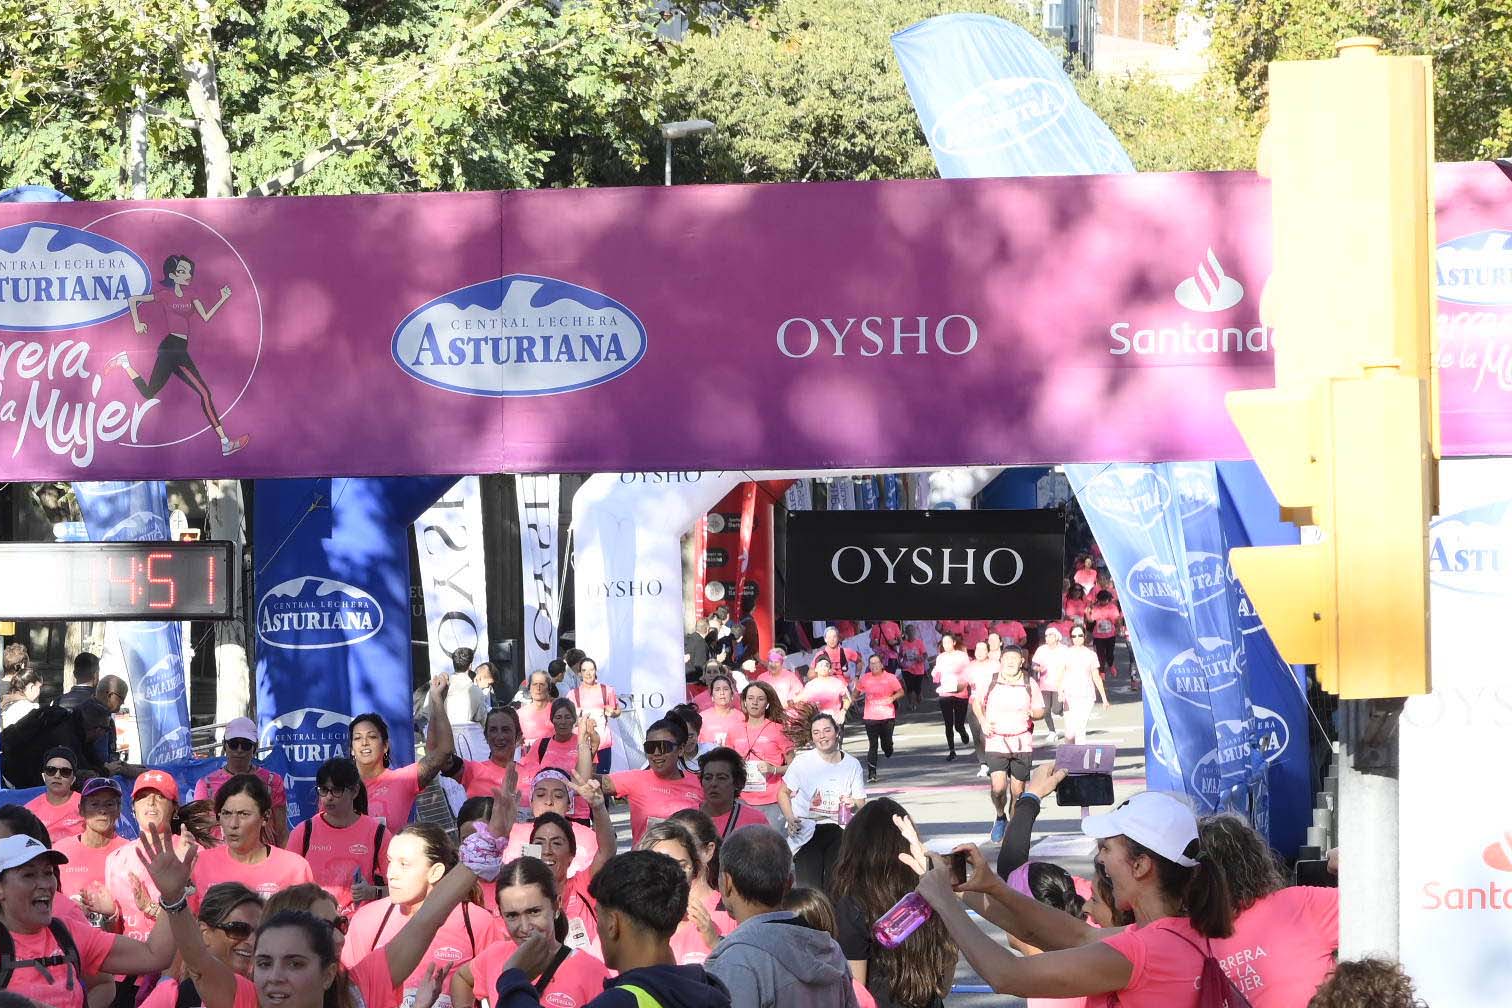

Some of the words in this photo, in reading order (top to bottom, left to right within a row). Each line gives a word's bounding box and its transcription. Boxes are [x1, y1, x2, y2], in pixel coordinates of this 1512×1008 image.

[53, 257, 126, 270] LECHERA
[451, 316, 529, 330] CENTRAL
[538, 314, 618, 328] LECHERA
[412, 321, 626, 368] ASTURIANA
[776, 313, 979, 359] OYSHO
[1110, 322, 1275, 356] Santand
[12, 374, 161, 468] Mujer
[831, 546, 1024, 586] OYSHO
[274, 602, 316, 610] CENTRAL
[321, 601, 369, 609] LECHERA
[261, 606, 374, 633] ASTURIANA
[322, 733, 349, 741] LECH
[283, 743, 347, 762] TURIA
[1219, 945, 1267, 971] RRERA
[1237, 964, 1257, 979] LA
